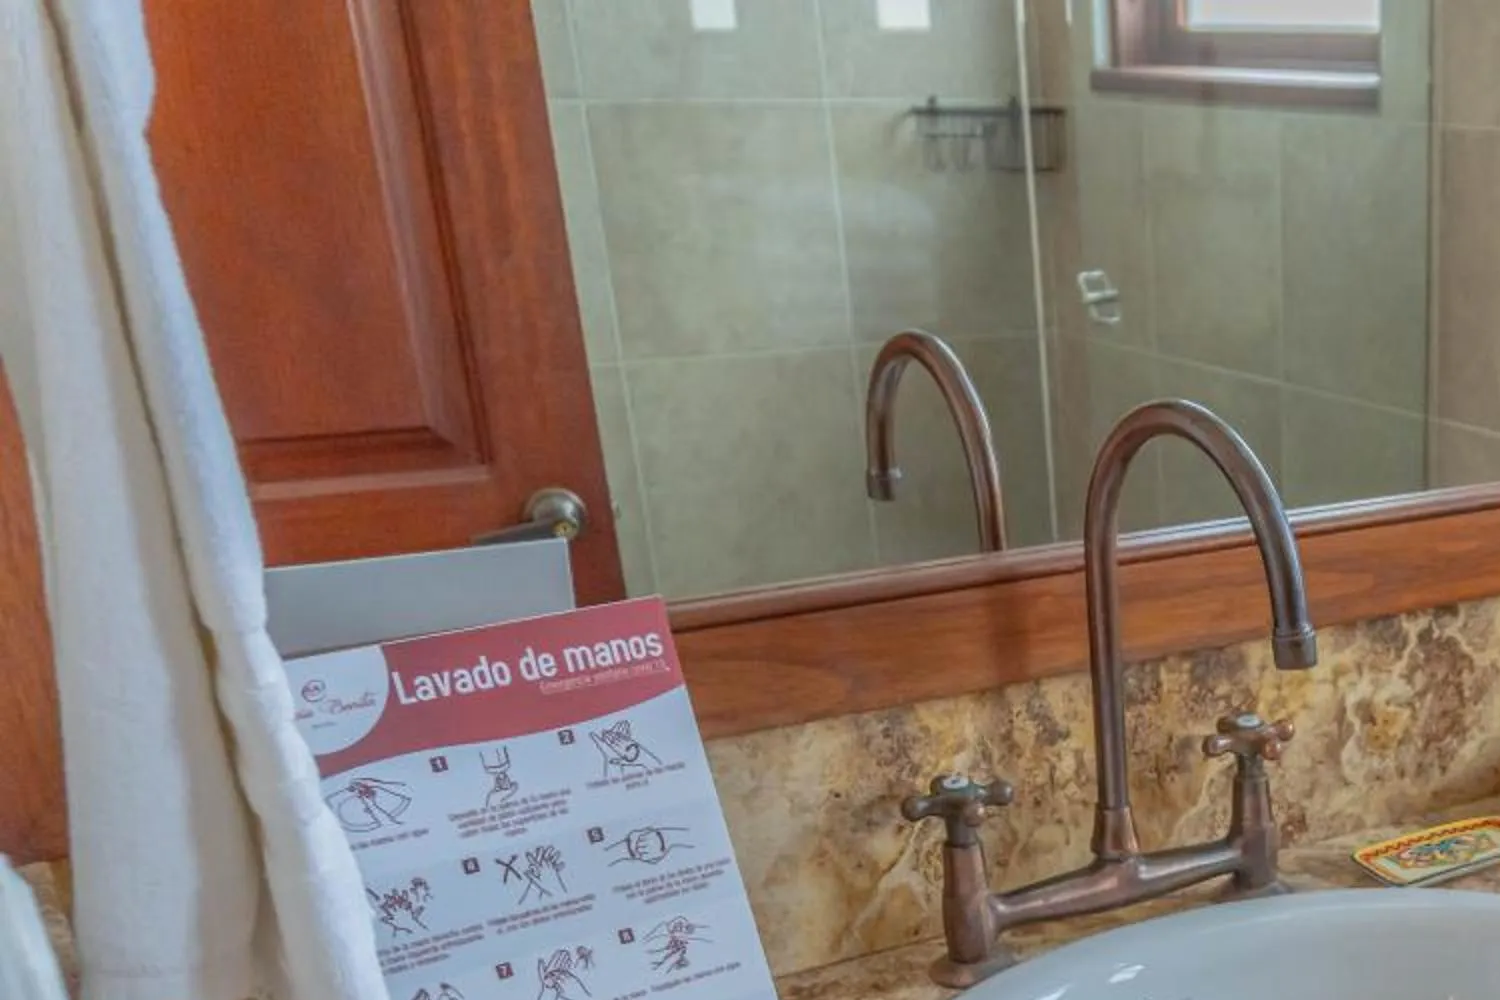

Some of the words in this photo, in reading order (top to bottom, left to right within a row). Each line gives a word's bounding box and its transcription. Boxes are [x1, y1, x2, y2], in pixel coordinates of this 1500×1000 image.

[391, 655, 512, 705] Lavado
[519, 646, 557, 681] de
[563, 632, 664, 673] manos
